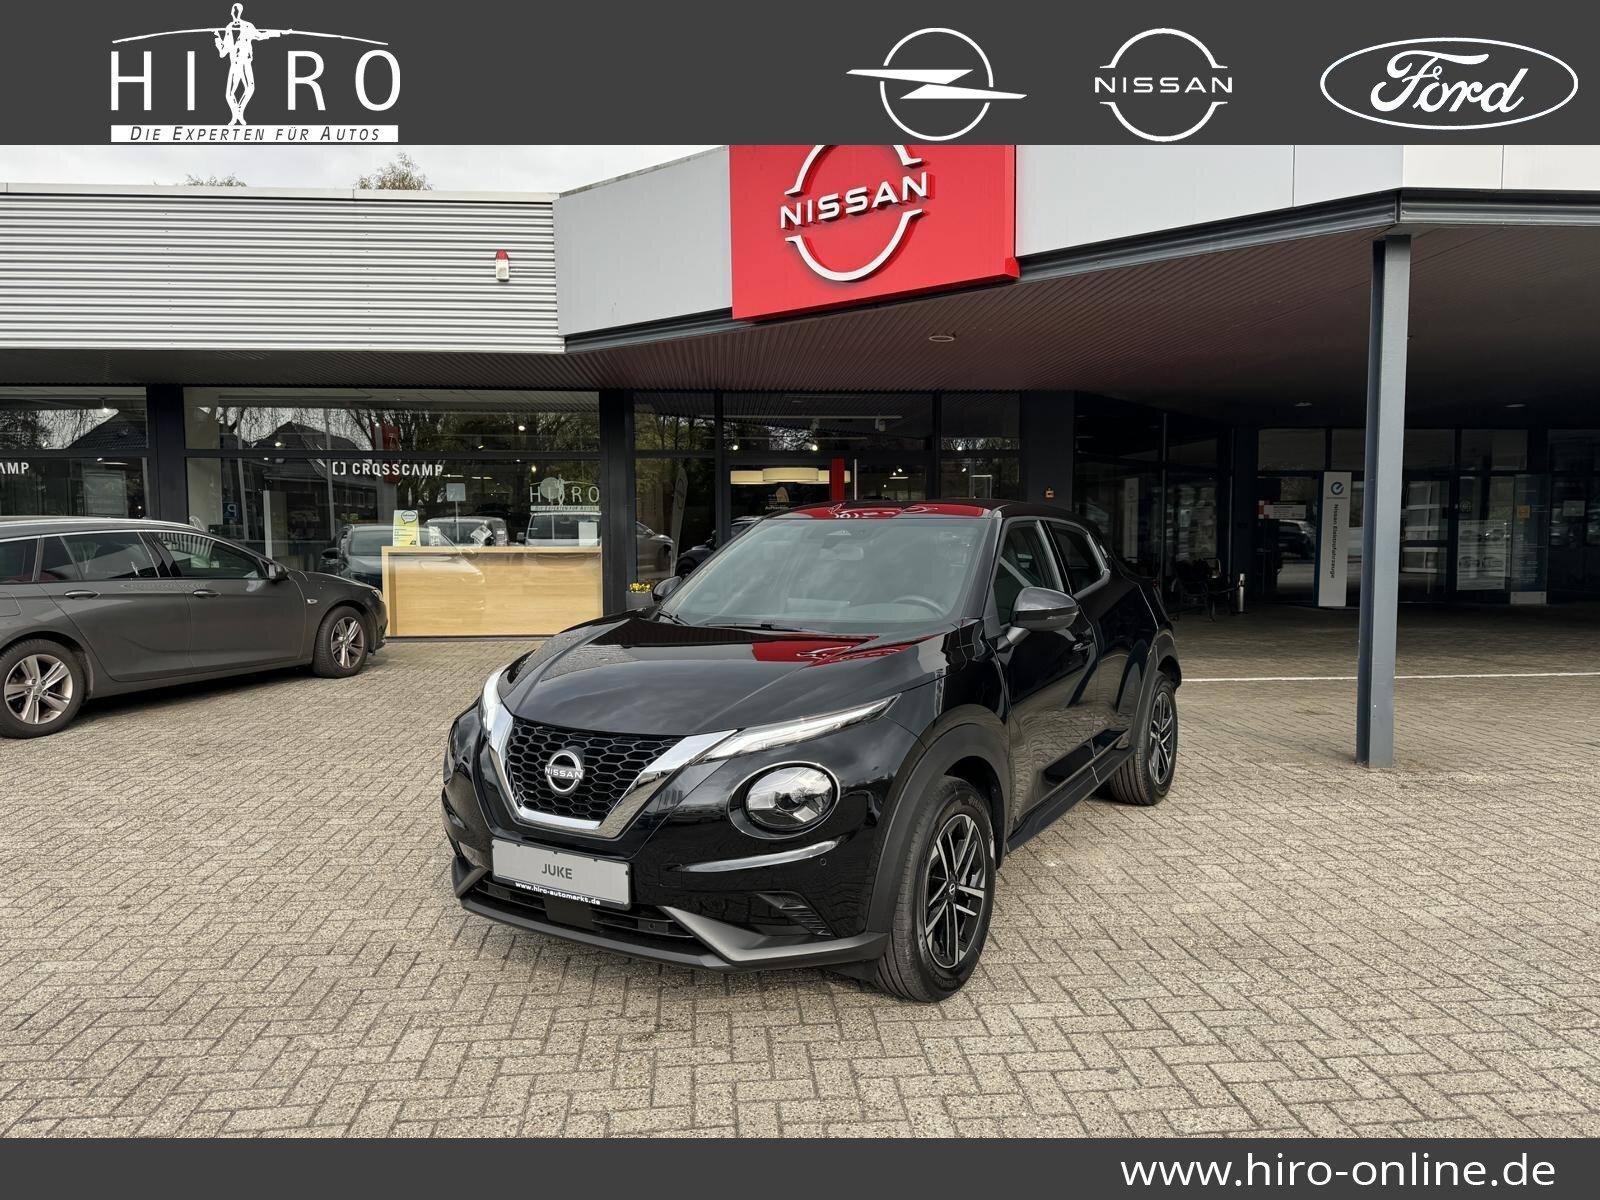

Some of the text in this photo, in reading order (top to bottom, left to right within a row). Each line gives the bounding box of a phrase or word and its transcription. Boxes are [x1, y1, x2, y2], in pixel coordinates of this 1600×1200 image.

[780, 172, 927, 229] NISSAN
[545, 766, 584, 780] NISSAN
[541, 863, 573, 880] JUKE
[515, 881, 601, 905] www.hiro-automarkt.de
